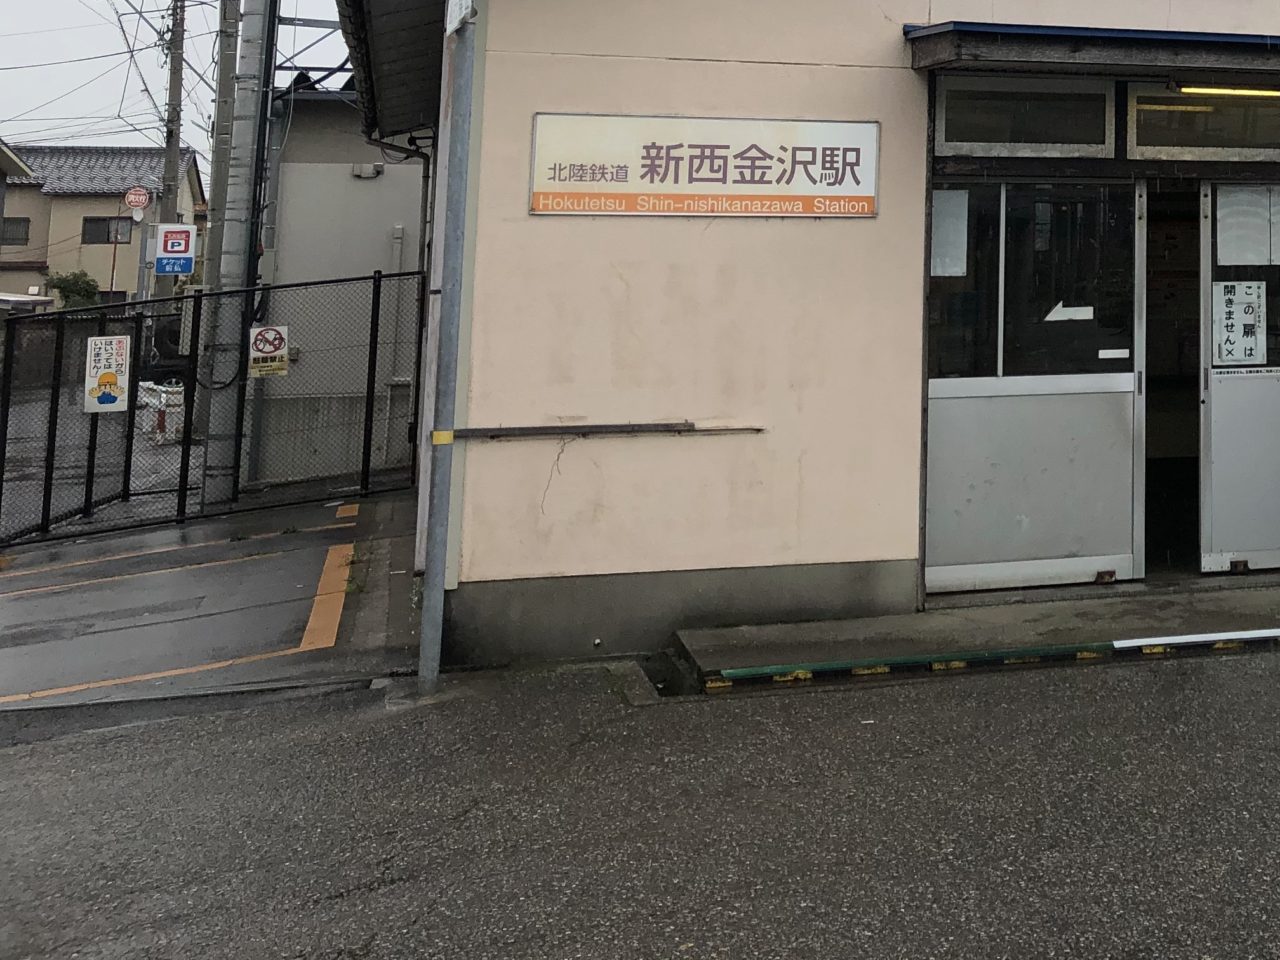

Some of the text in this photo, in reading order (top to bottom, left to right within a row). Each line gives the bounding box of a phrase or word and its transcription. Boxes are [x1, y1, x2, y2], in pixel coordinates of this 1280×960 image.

[547, 141, 862, 187] 北陸鉄道 新西金沢駅
[538, 194, 869, 214] Hokutetsu Shin-nishikanazawa Station
[170, 241, 182, 250] P
[161, 258, 187, 266] チケット
[1242, 285, 1256, 358] この扉は
[115, 340, 125, 375] あぶないから
[252, 353, 287, 365] 駐輪禁止
